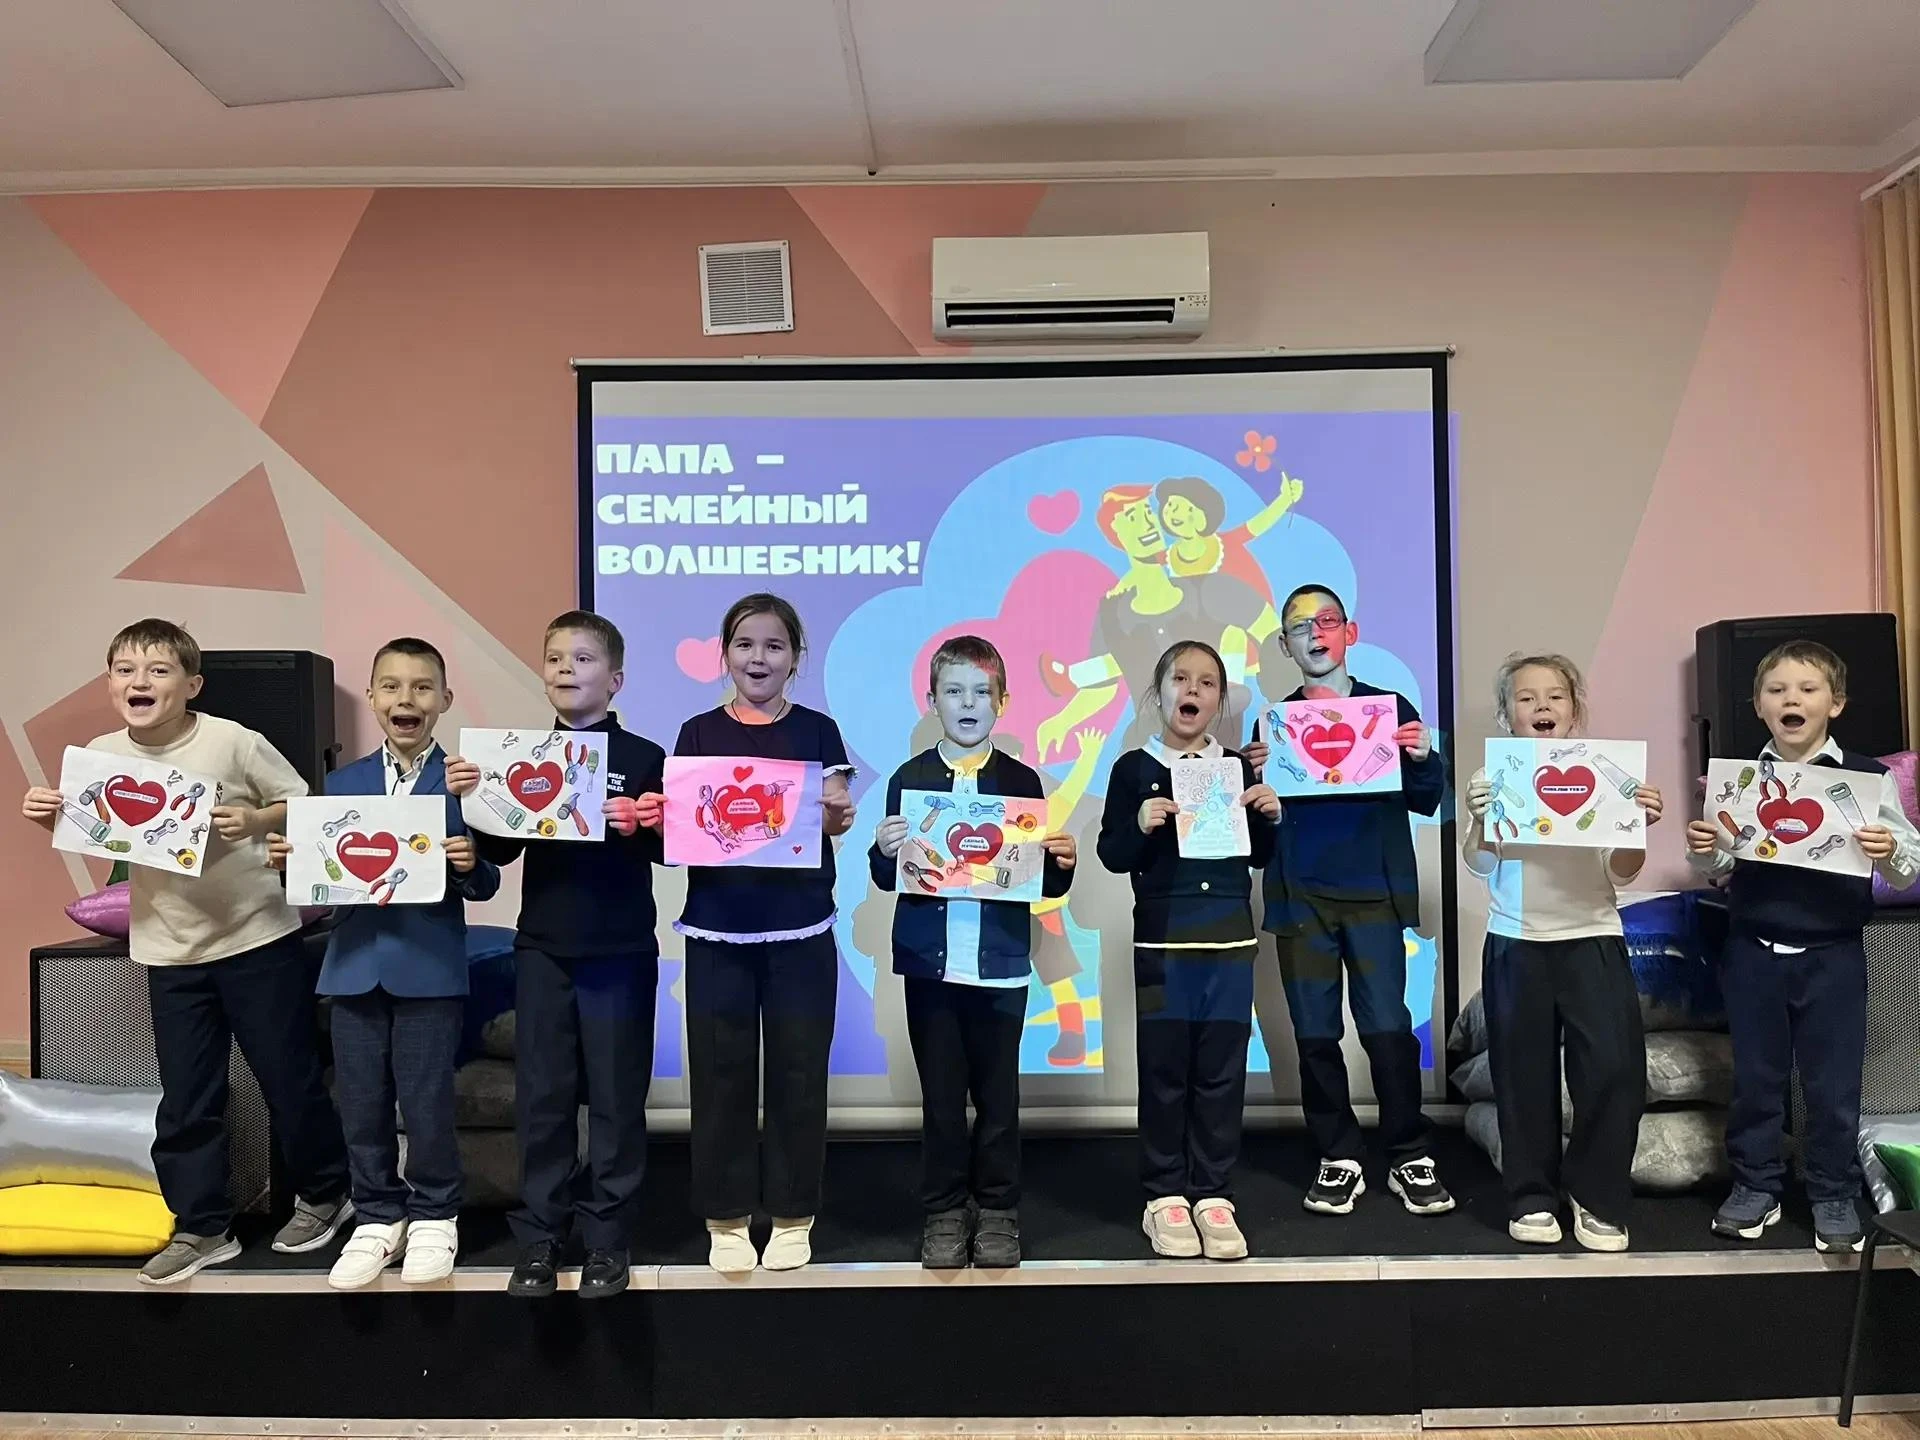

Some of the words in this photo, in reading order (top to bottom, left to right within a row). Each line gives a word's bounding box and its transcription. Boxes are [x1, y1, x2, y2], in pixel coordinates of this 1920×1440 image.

[597, 444, 734, 474] ПАПА
[597, 483, 867, 524] СЕМЕЙНЫЙ
[598, 541, 921, 576] ВОЛШЕБНИК!
